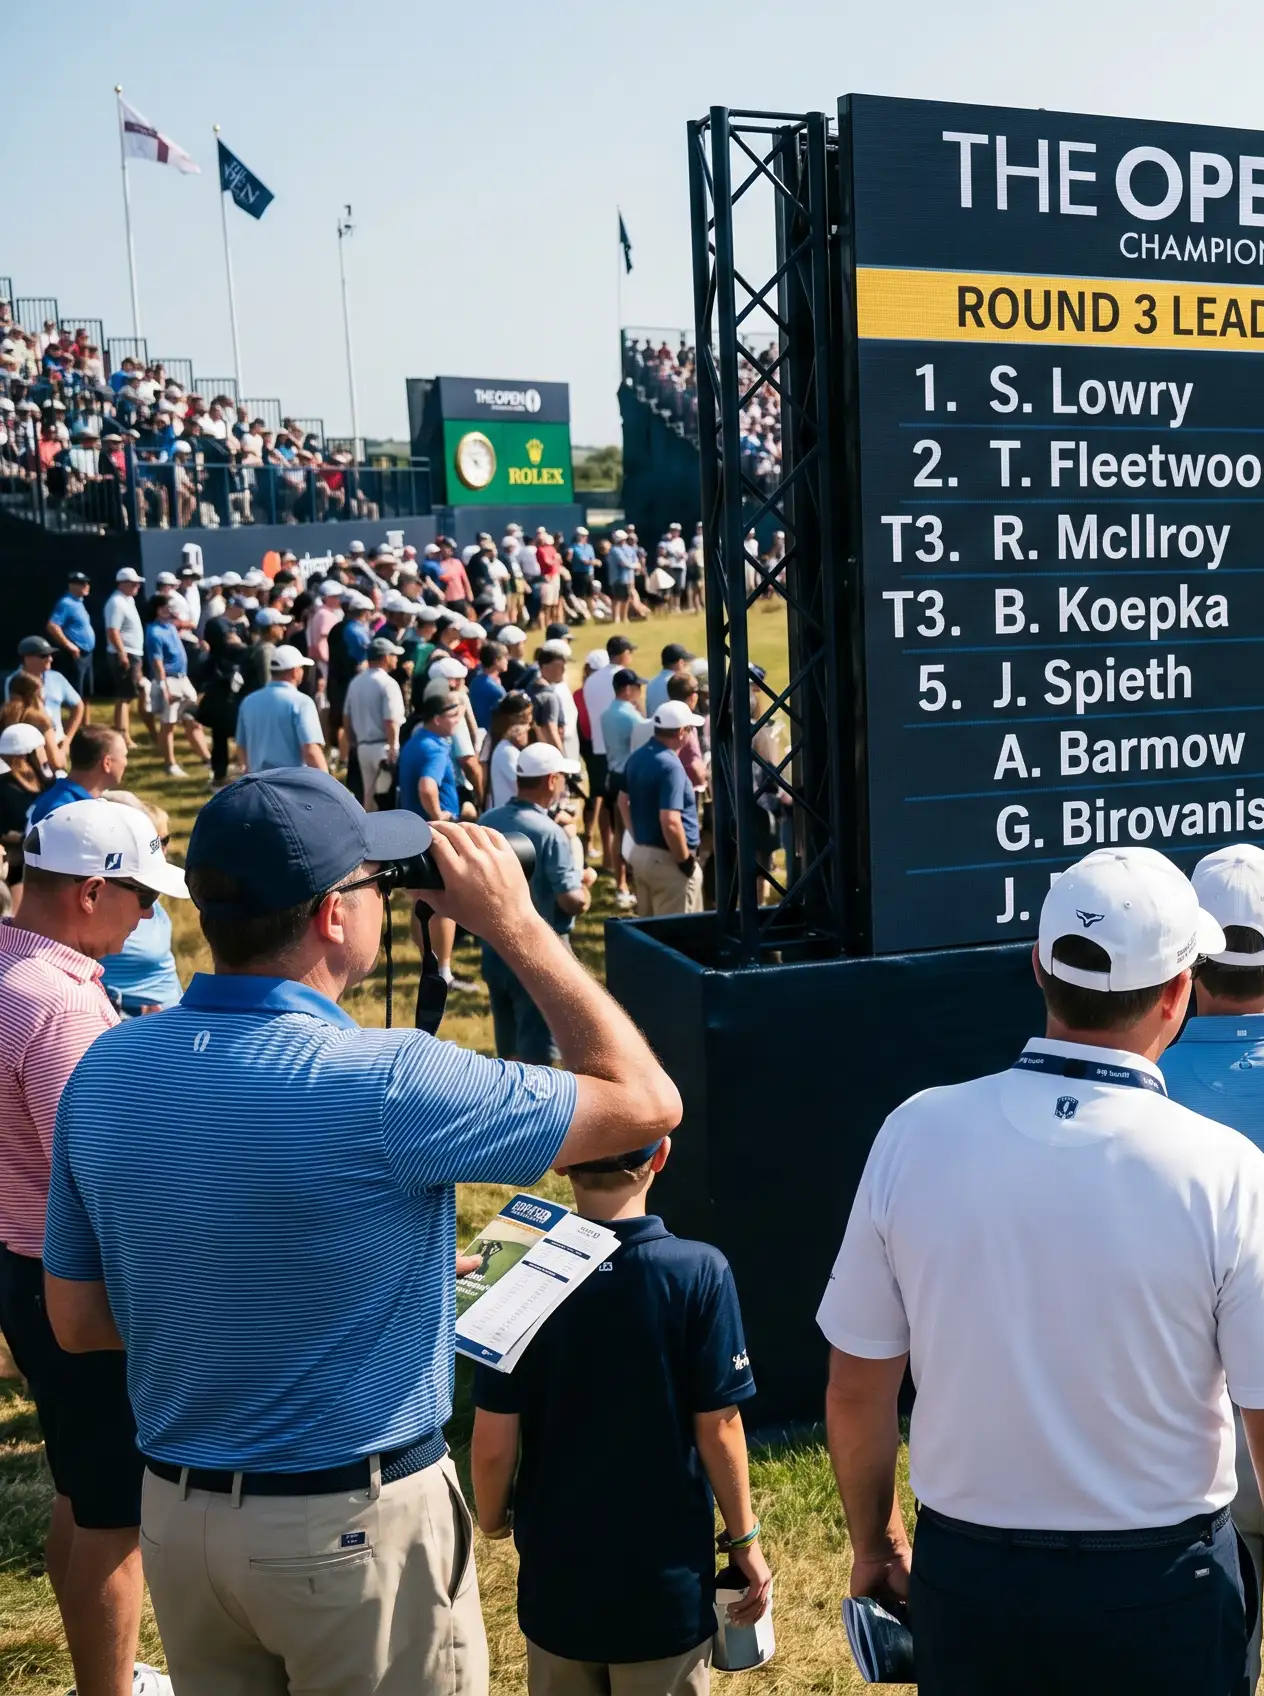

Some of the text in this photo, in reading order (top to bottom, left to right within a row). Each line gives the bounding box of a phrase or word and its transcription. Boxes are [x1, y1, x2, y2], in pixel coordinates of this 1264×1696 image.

[942, 130, 1098, 217] THE
[957, 285, 1120, 333] ROUND
[1133, 293, 1158, 335] 3
[915, 363, 957, 412] 1.
[989, 364, 1033, 413] S.
[1052, 367, 1194, 429] Lowry
[508, 467, 564, 485] ROLEX
[912, 439, 958, 487] 2.
[989, 440, 1031, 487] T.
[880, 514, 960, 563] T3.
[993, 515, 1038, 561] R.
[1057, 513, 1231, 570] McIlroy
[882, 589, 961, 638] T3.
[994, 588, 1039, 635] B.
[1058, 583, 1229, 641] Koepka
[918, 664, 962, 712] 5.
[993, 661, 1026, 708] J.
[1044, 654, 1192, 715] Spieth
[993, 733, 1041, 780] A.
[1060, 730, 1246, 776] Barmow
[996, 803, 1044, 852] G.
[996, 876, 1030, 924] J.
